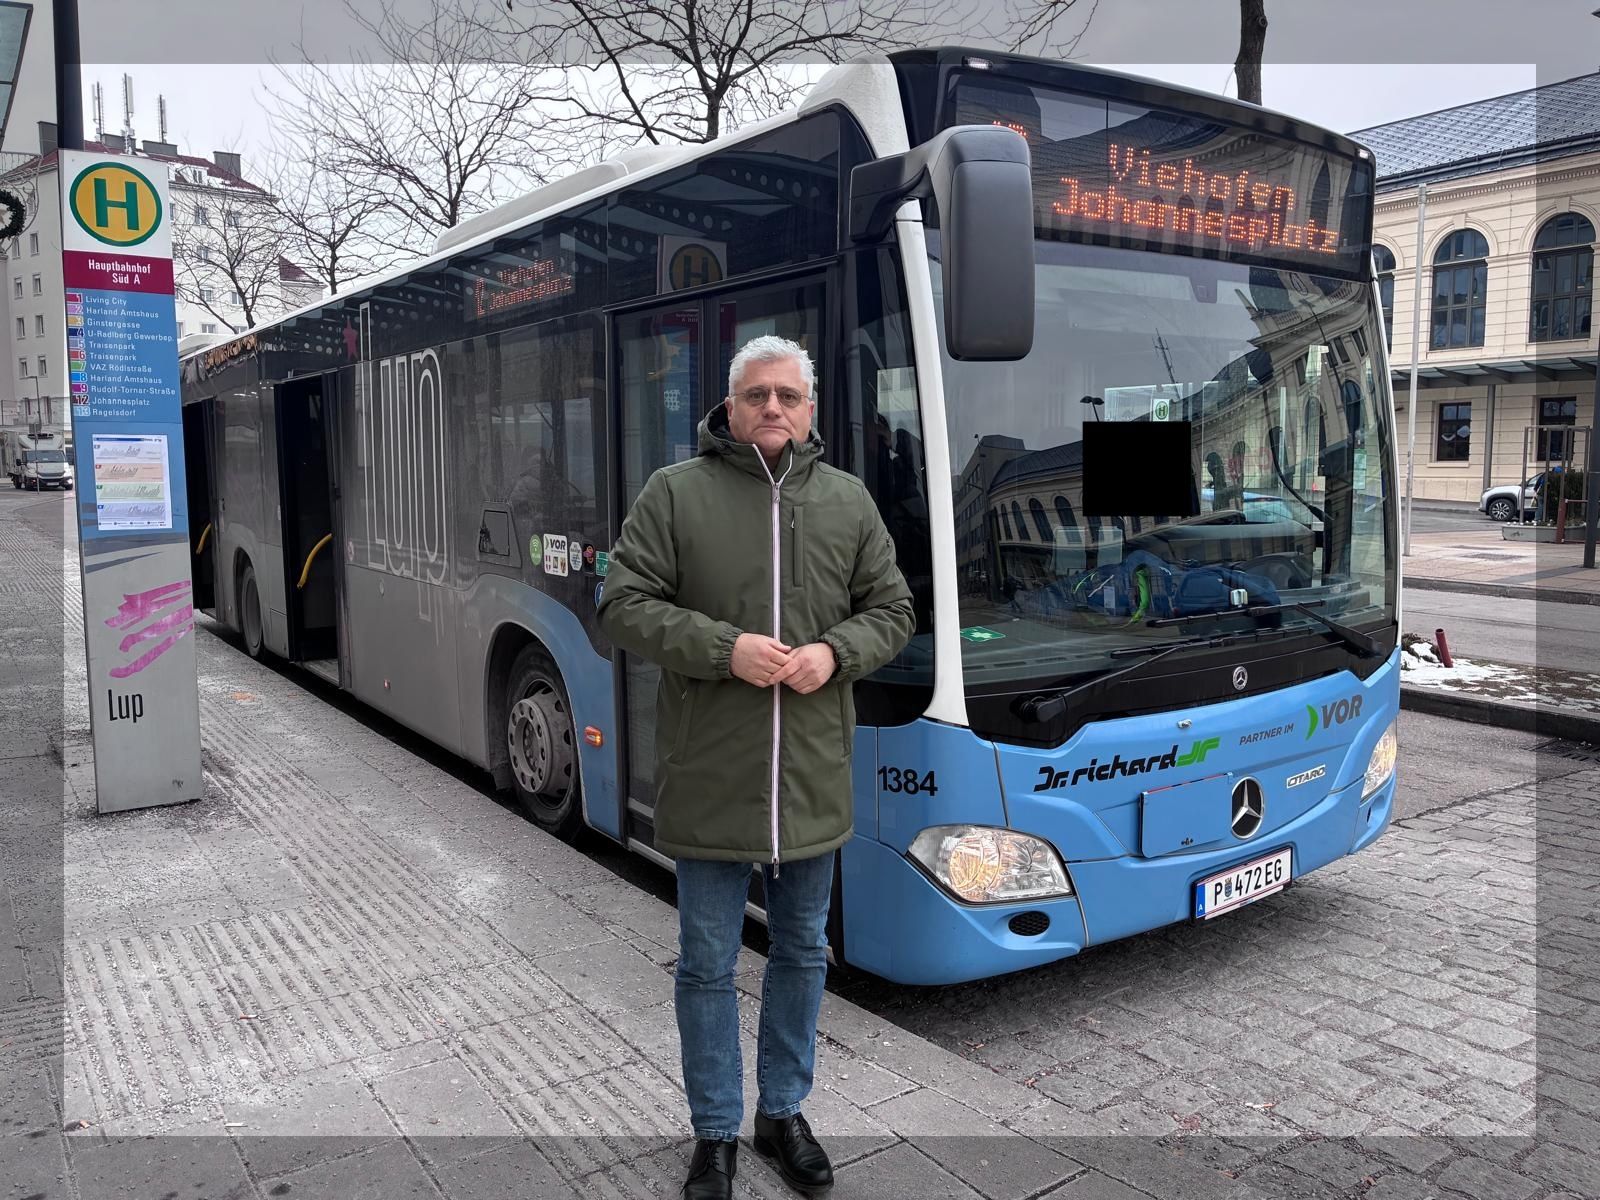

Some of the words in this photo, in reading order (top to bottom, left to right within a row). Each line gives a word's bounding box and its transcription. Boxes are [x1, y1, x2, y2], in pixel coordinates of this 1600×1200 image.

[1109, 143, 1295, 211] Viehofen
[94, 178, 139, 231] H
[1052, 176, 1338, 254] Johannesplatz
[88, 259, 151, 274] Hauptbahnhof
[112, 273, 129, 285] Süd
[134, 276, 141, 285] A
[86, 296, 109, 306] Living
[111, 297, 127, 306] City
[86, 307, 118, 316] Harland
[120, 309, 159, 318] Amtshaus
[87, 318, 141, 329] Ginstergasse
[88, 330, 132, 340] U-Radlberg
[134, 333, 174, 342] Gewerbep.
[89, 341, 136, 351] Traisenpark
[90, 353, 137, 362] Traisenpark
[90, 375, 122, 383] Harland
[124, 376, 162, 384] Amtshaus
[92, 397, 150, 407] Johannesplatz
[549, 538, 566, 550] VOR
[107, 689, 144, 723] Lup
[1239, 726, 1283, 746] PARTNER
[1284, 723, 1295, 733] IM
[1321, 694, 1363, 729] VOR
[878, 765, 938, 797] 1384
